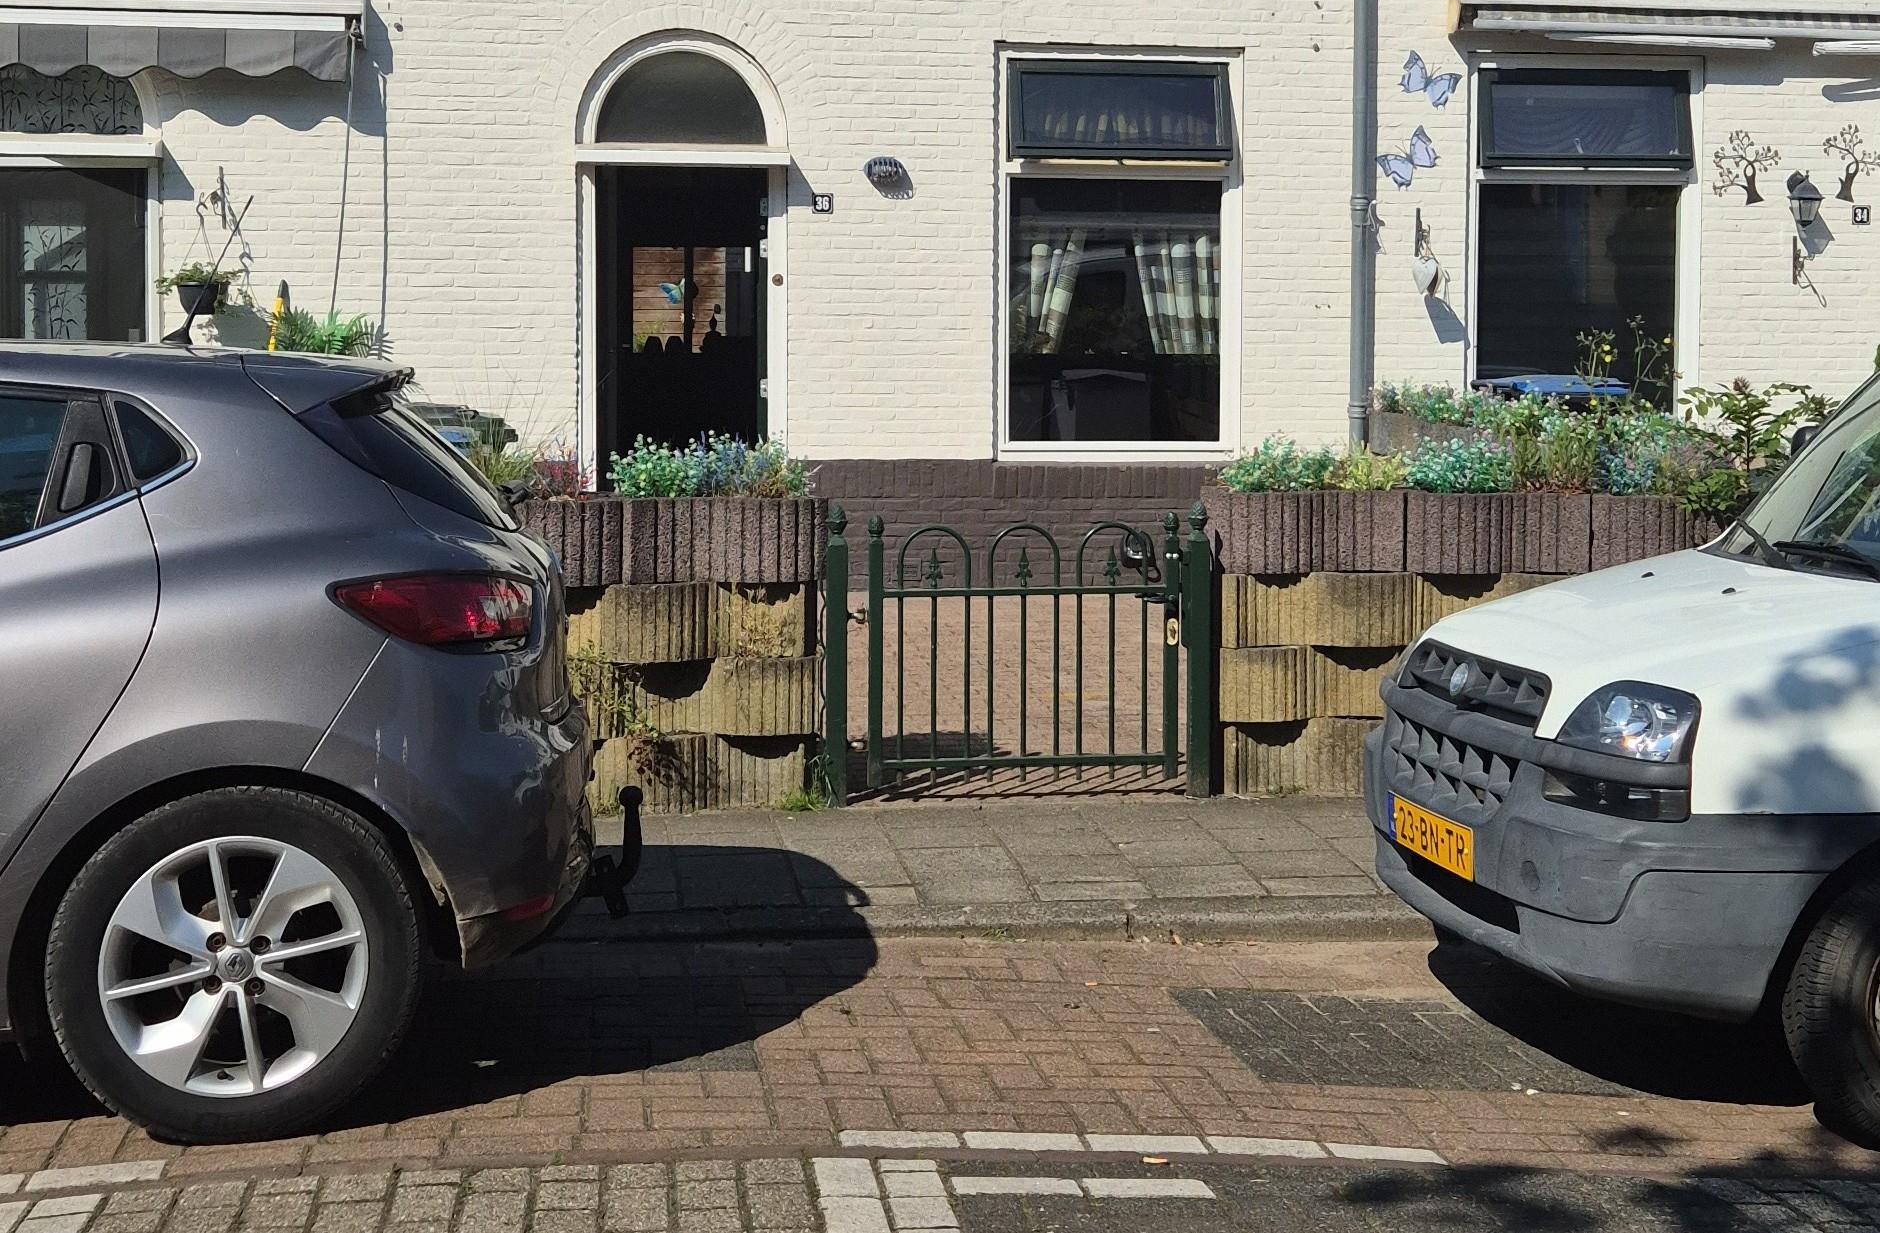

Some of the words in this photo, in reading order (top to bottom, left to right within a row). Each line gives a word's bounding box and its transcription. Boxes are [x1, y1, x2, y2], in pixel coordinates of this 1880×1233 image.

[815, 196, 830, 211] 36
[1855, 208, 1868, 222] 34
[1399, 806, 1466, 872] 23-BN-TR
